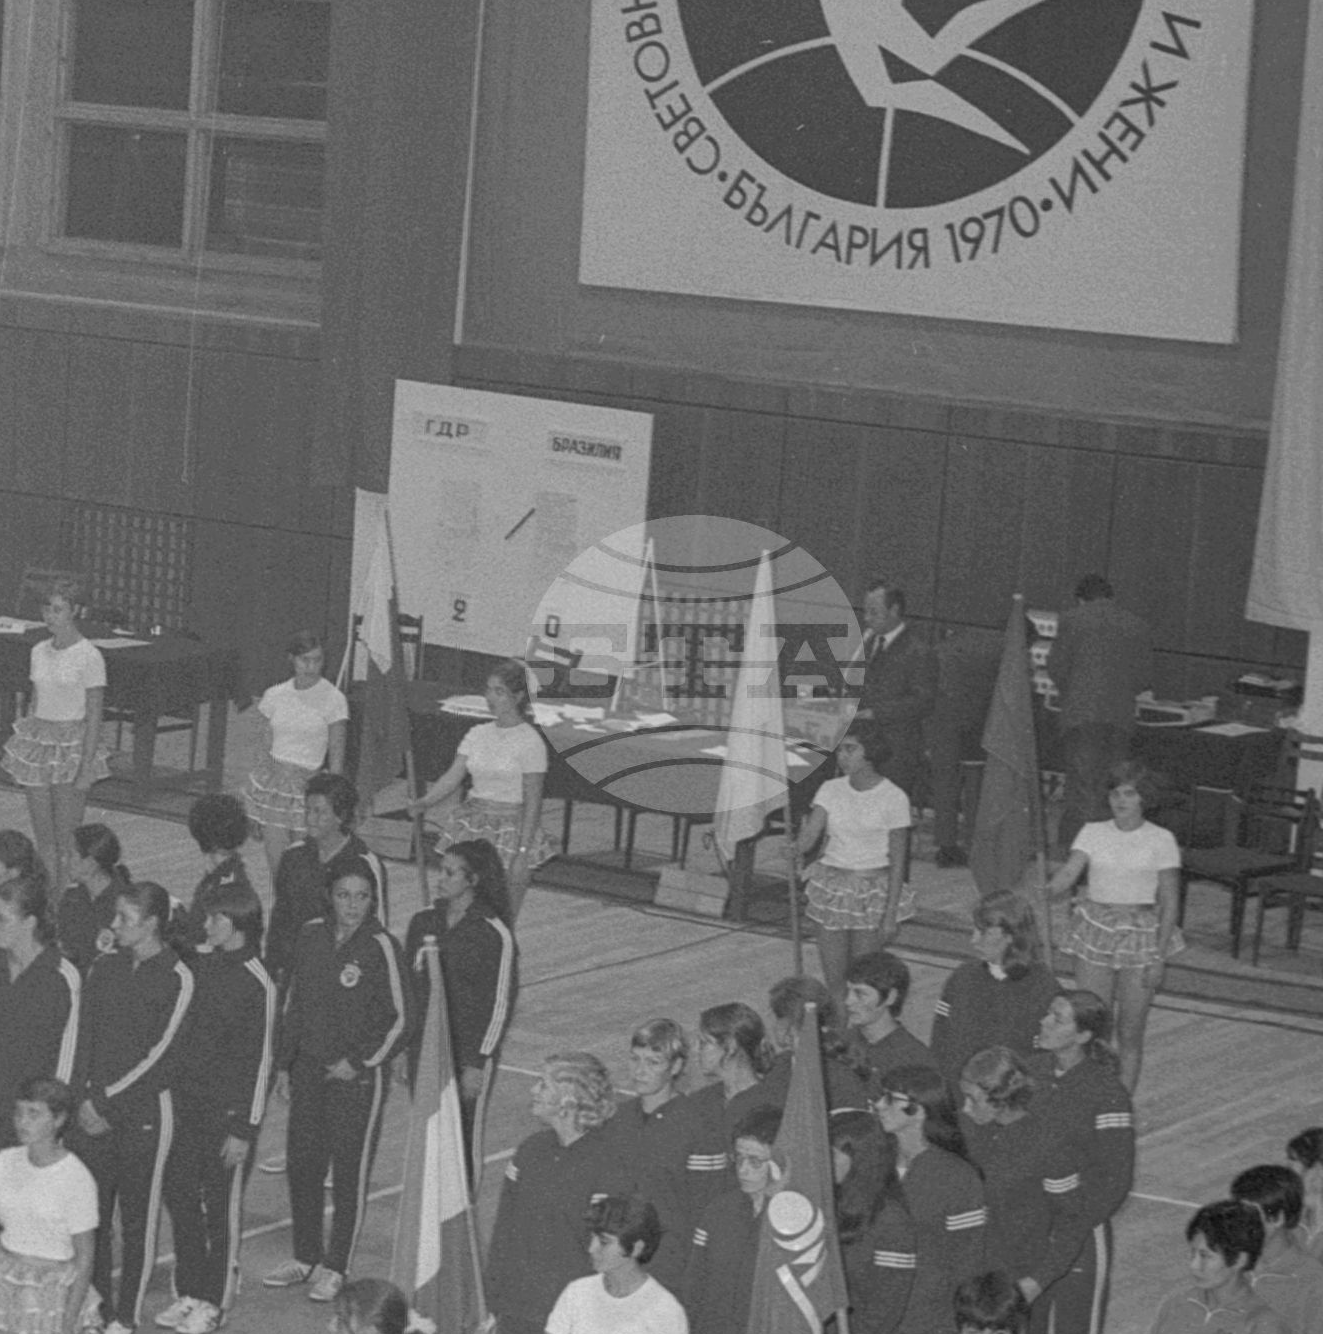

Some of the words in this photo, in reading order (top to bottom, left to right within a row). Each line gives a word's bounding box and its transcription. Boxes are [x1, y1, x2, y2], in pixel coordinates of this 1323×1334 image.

[1149, 11, 1202, 60] И
[1048, 57, 1179, 214] ЖЕНИ
[723, 169, 931, 269] БЪЛГАРИЯ
[944, 195, 1040, 263] 1970
[425, 419, 470, 439] ГДР
